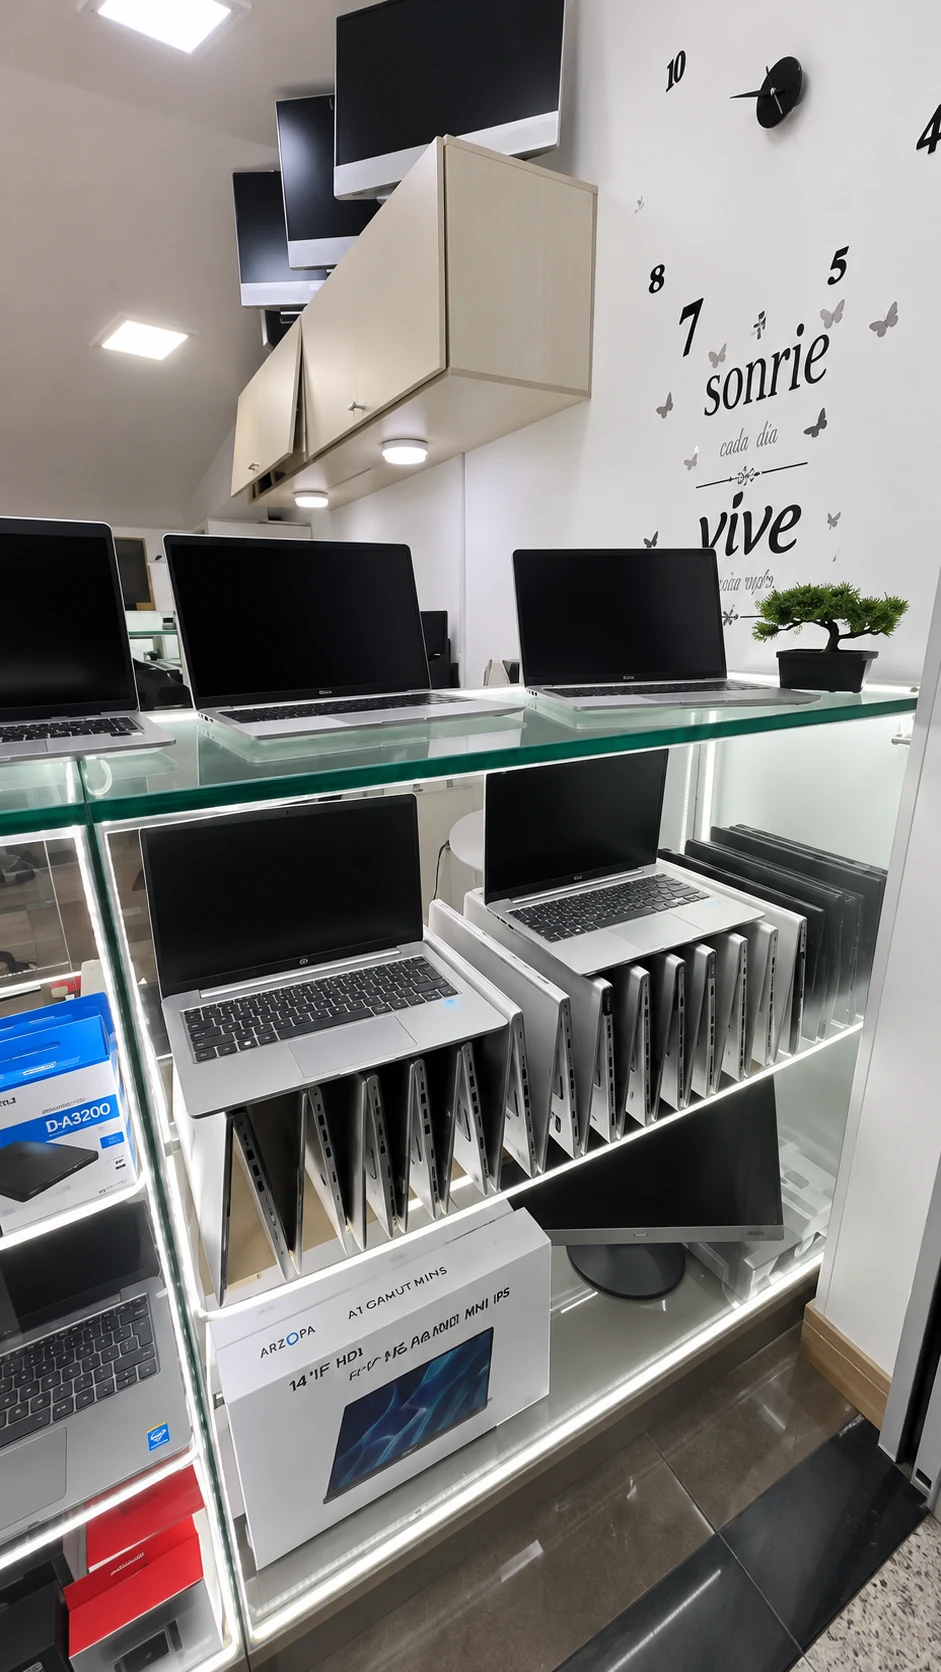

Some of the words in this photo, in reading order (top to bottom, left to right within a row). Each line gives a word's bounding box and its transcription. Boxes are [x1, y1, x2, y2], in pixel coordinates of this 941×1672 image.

[665, 50, 687, 92] 10
[916, 103, 941, 154] 4
[648, 264, 665, 294] 8
[827, 246, 849, 285] 5
[679, 298, 704, 358] 7
[719, 427, 749, 457] cada
[699, 491, 802, 557] vive
[45, 1102, 111, 1133] D-A3200
[366, 1281, 411, 1310] GAMUT
[413, 1266, 448, 1287] MINS
[260, 1325, 316, 1358] ARZOPA
